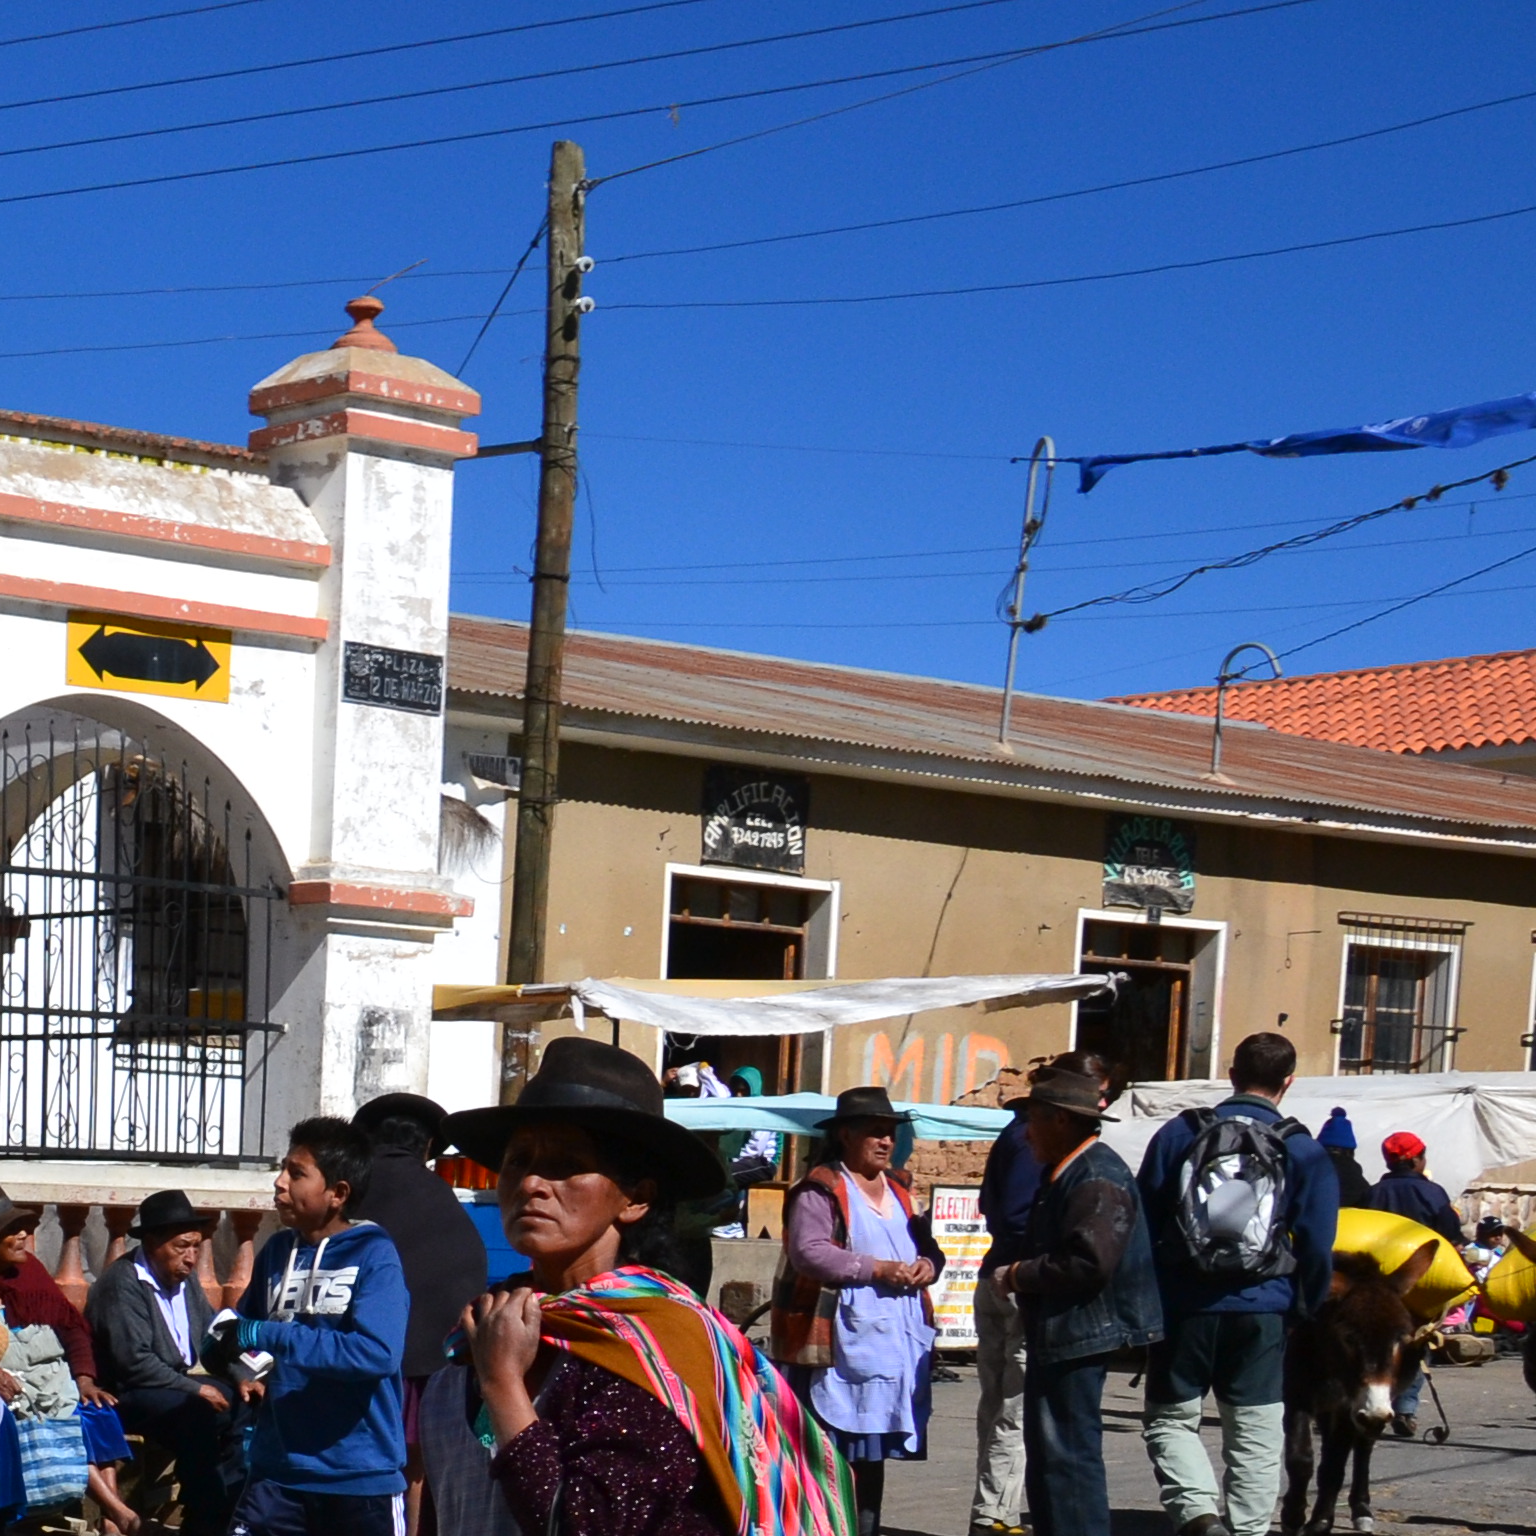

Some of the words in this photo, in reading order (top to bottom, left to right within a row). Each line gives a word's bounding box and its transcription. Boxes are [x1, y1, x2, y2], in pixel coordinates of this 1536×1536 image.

[384, 654, 427, 675] PLAZA
[369, 675, 381, 697] 12
[383, 677, 399, 699] DE
[401, 680, 439, 705] MARZO
